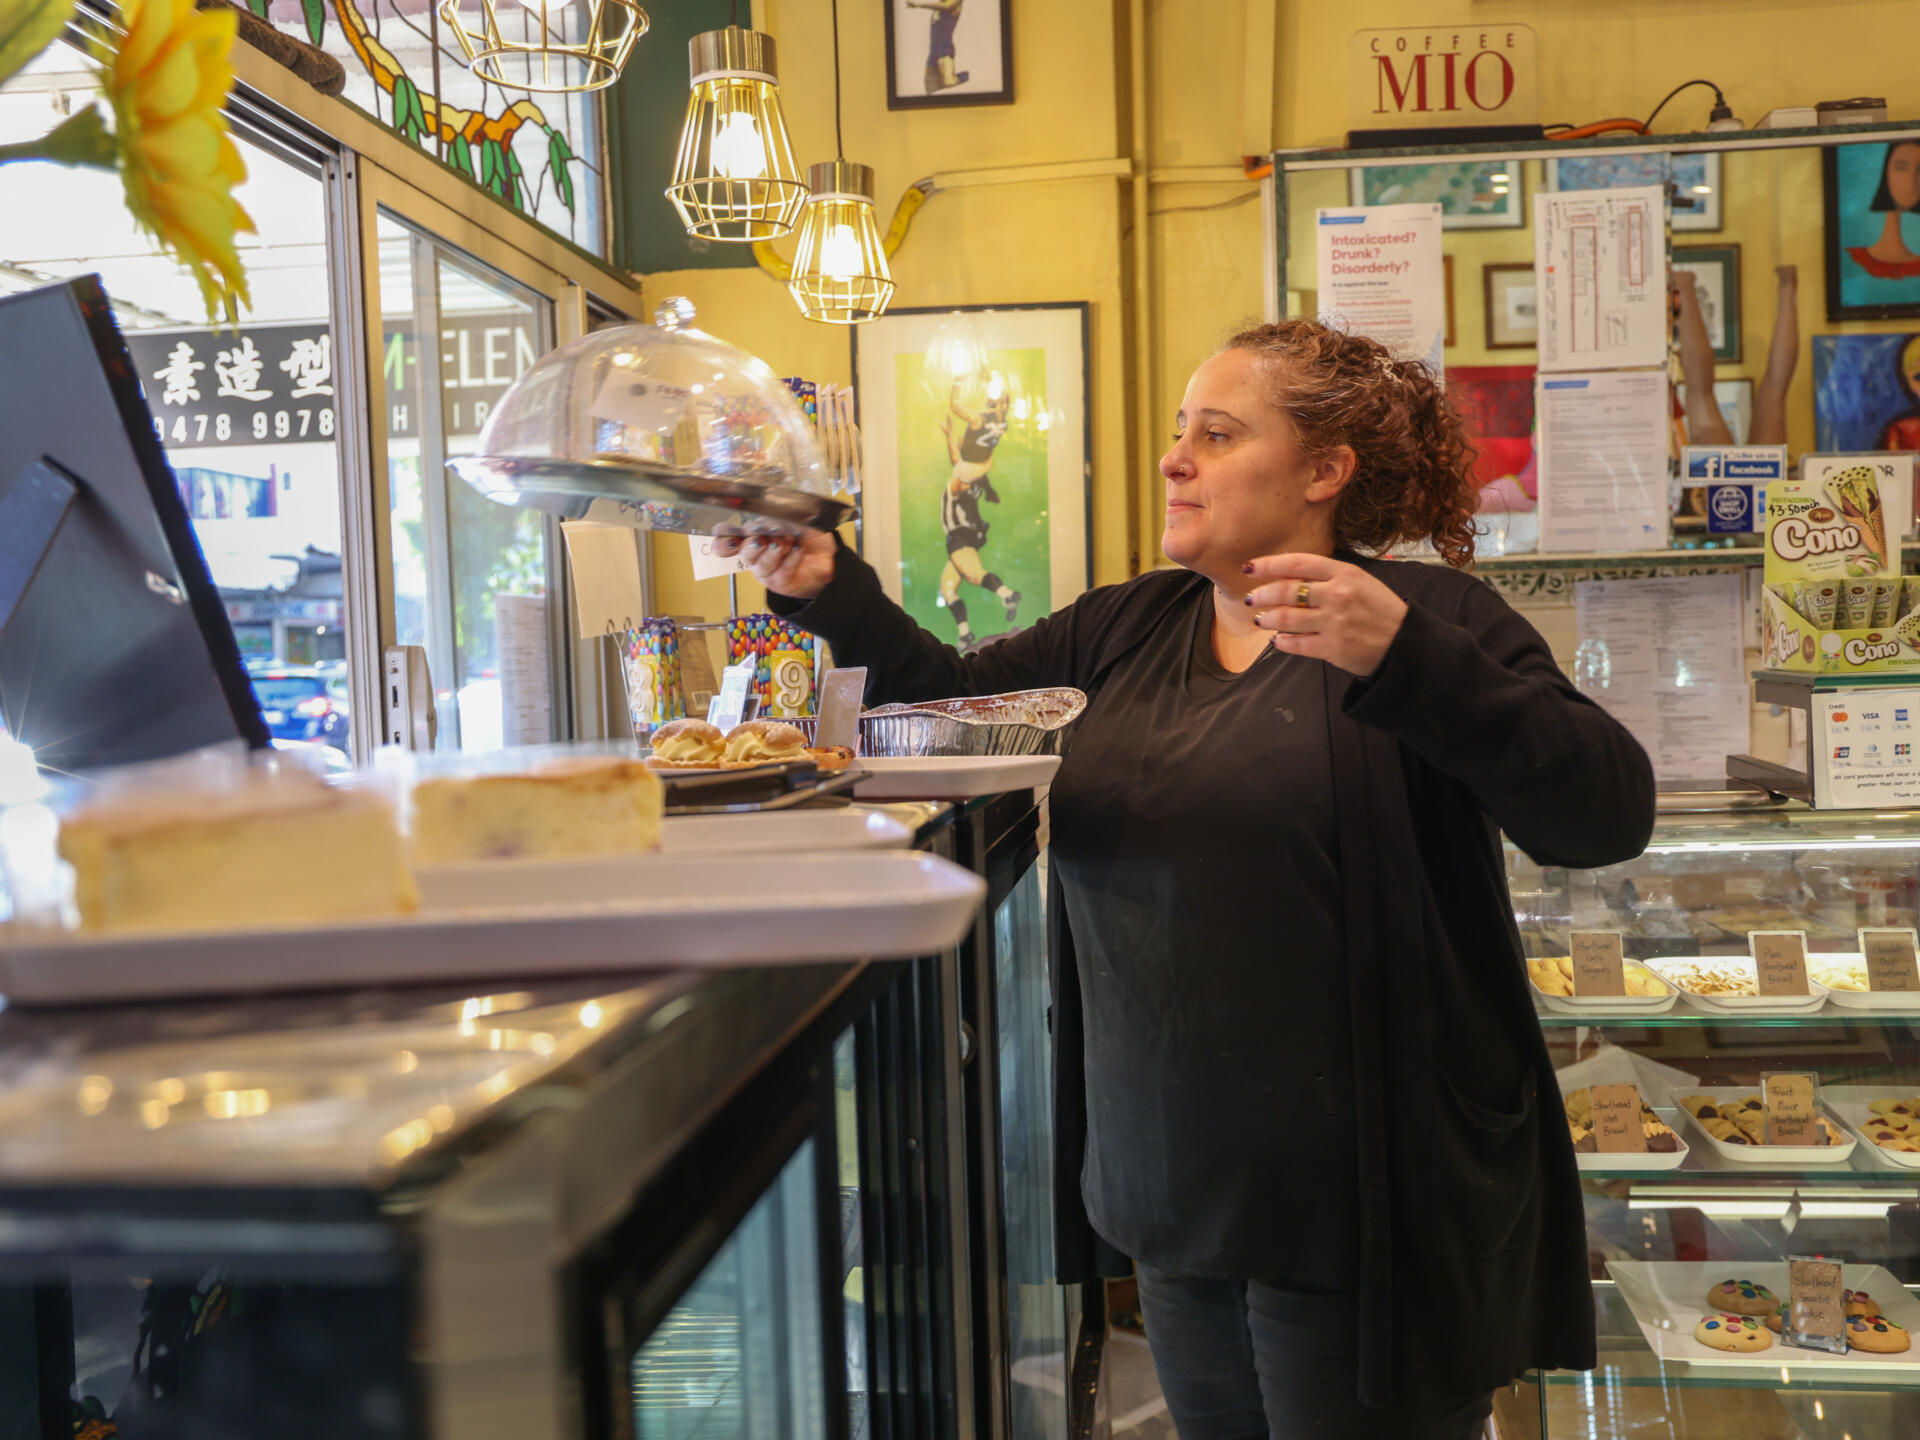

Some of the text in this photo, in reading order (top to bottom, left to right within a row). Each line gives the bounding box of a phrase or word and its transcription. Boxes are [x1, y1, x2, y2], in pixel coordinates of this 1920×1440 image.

[1370, 32, 1515, 53] COFFEE
[1371, 50, 1515, 113] MIO
[1331, 231, 1417, 246] Intoxicated?
[1332, 247, 1381, 260] Drunk?
[1332, 261, 1410, 275] Disorderly?
[139, 333, 335, 406] 素造型
[252, 408, 334, 440] 9978
[392, 401, 489, 432] HIR
[1736, 452, 1754, 460] Like
[1729, 465, 1774, 475] facebook
[1800, 499, 1820, 512] each
[1772, 517, 1861, 561] Cono
[1778, 621, 1800, 663] Cono
[1844, 638, 1900, 665] Cono
[775, 657, 811, 709] 9
[1862, 712, 1880, 720] VISA
[1857, 772, 1884, 780] purchases
